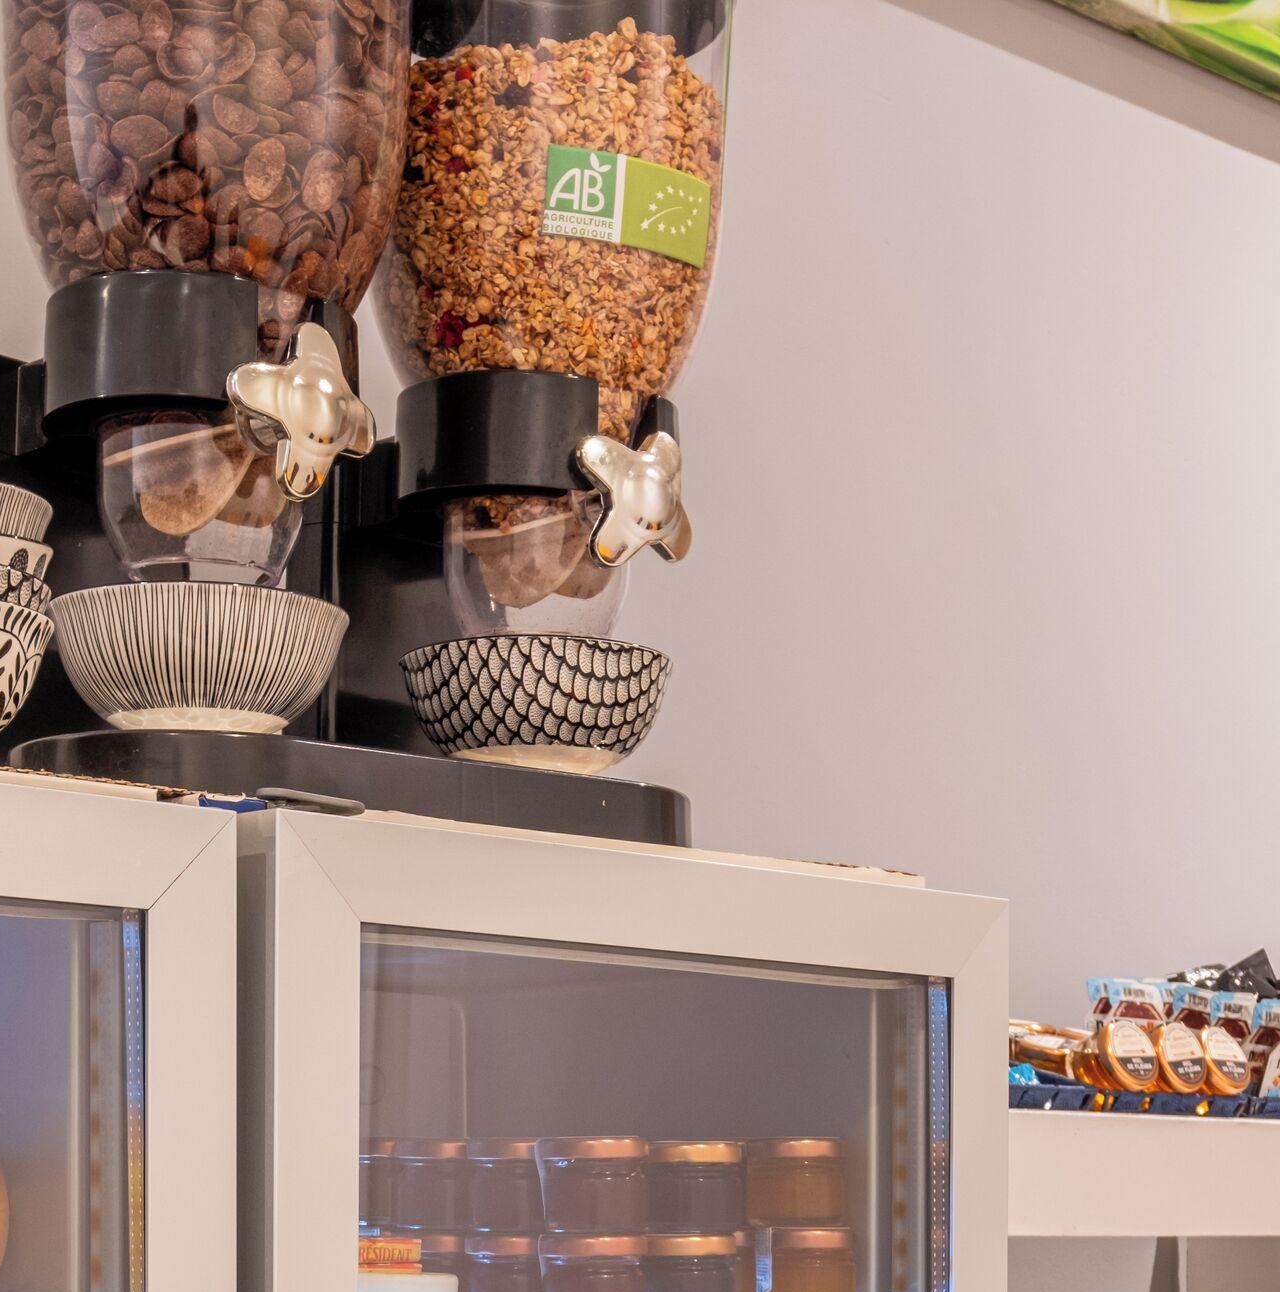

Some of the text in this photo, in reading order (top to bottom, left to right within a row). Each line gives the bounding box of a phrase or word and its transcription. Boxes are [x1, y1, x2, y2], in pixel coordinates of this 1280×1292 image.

[549, 167, 605, 212] AB
[543, 213, 614, 229] AGRICULTURE
[543, 223, 614, 240] BIOLOGIQUE
